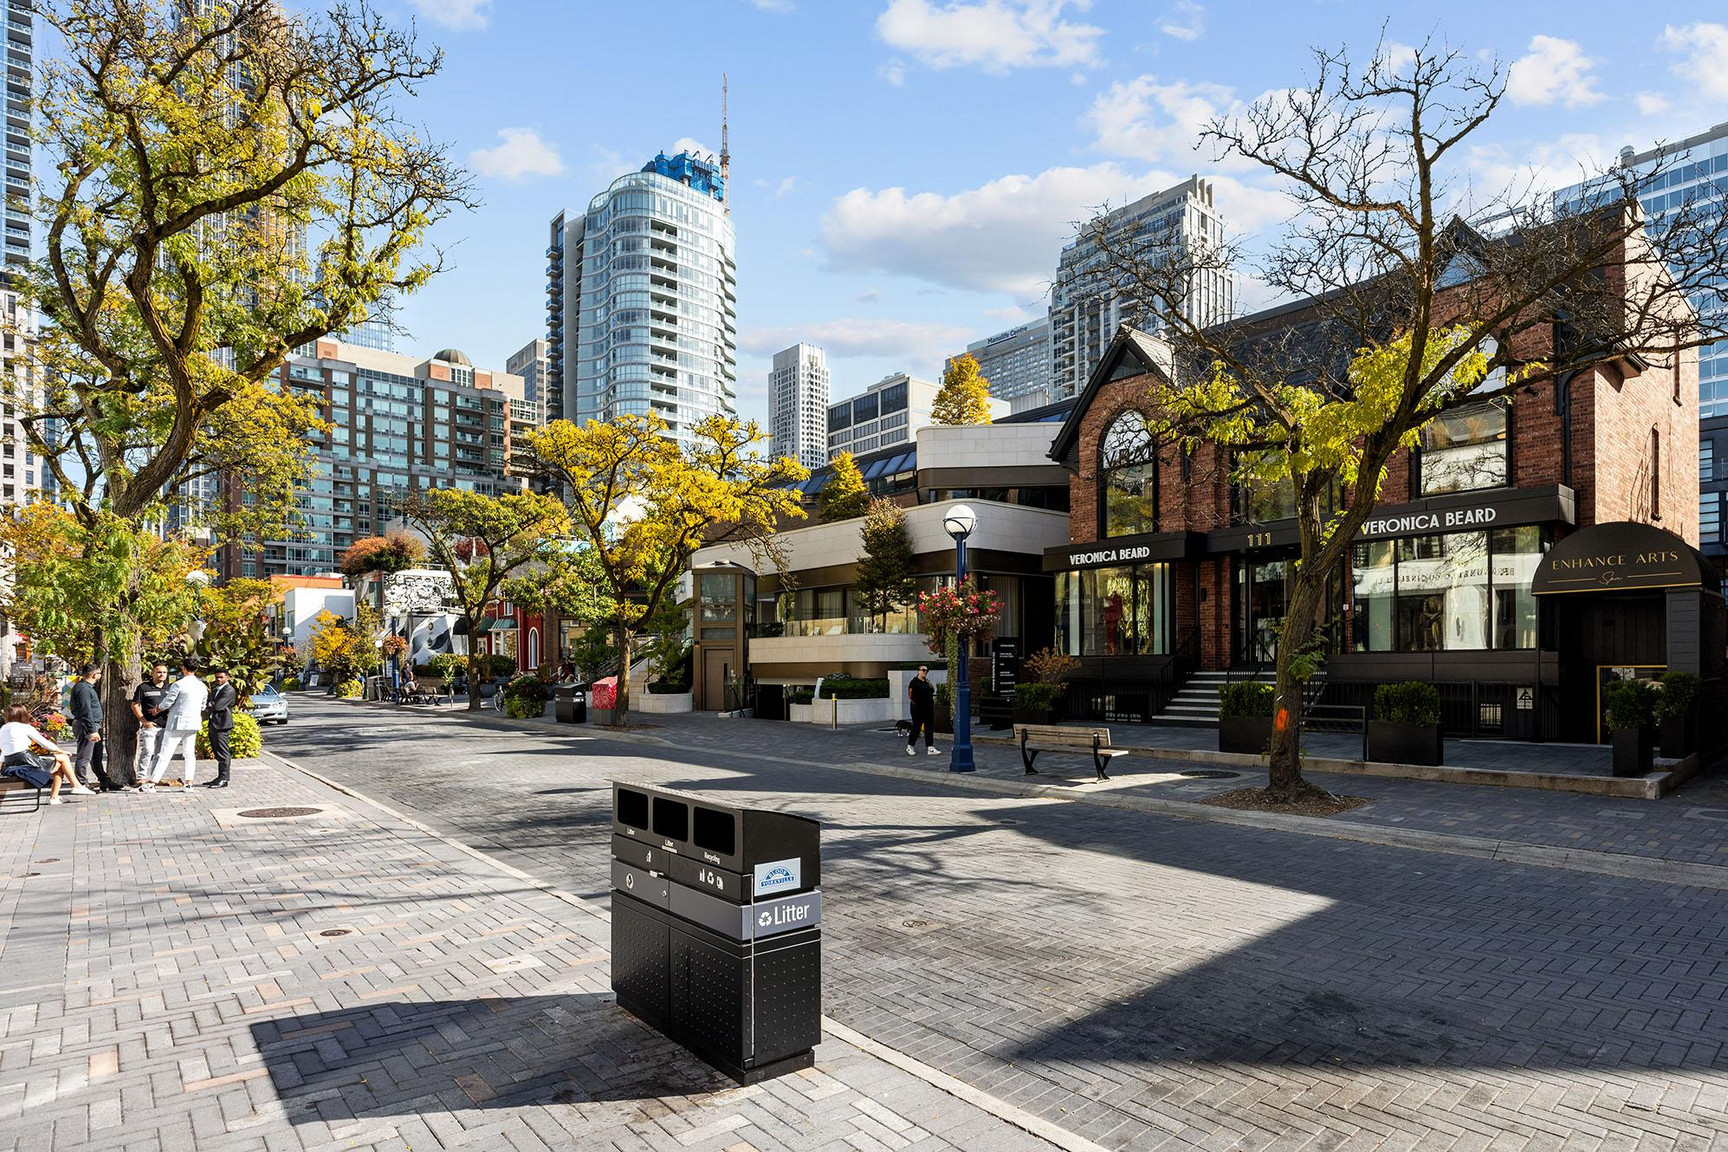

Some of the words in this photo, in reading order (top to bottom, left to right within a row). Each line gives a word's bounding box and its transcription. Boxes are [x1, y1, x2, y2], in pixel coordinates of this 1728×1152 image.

[1360, 514, 1440, 535] VERONICA
[1445, 507, 1497, 526] BEARD
[1247, 532, 1271, 547] 111
[1069, 550, 1117, 565] VERONICA
[1119, 546, 1150, 560] BEARD
[1552, 554, 1626, 570] ENHANCE
[1635, 550, 1679, 564] ARTS
[774, 904, 810, 925] Litter
